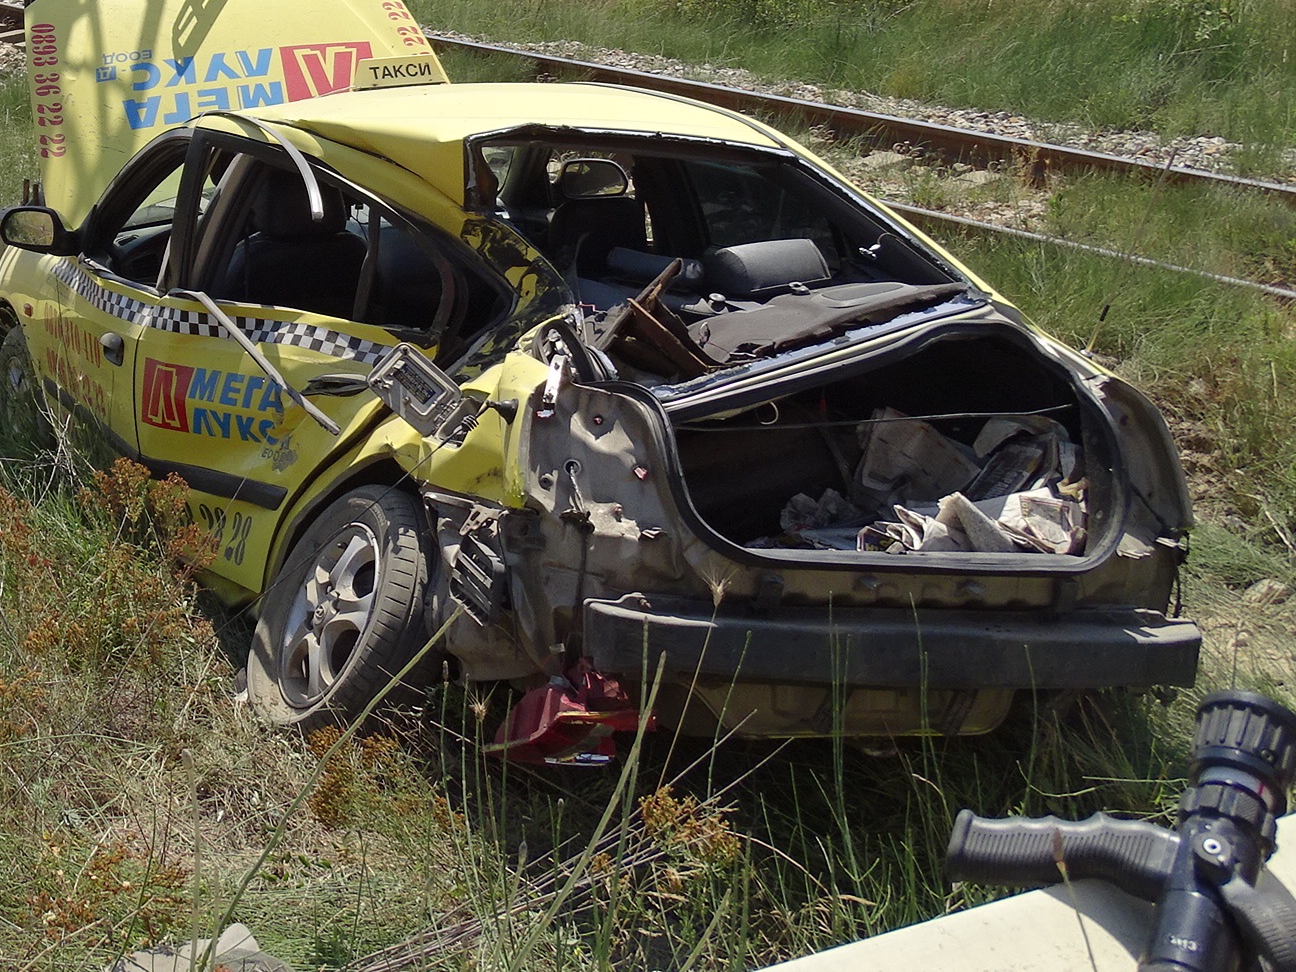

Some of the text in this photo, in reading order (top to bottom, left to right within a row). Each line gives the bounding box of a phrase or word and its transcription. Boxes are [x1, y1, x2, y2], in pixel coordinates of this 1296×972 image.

[30, 23, 66, 159] 0893 36 22 22
[368, 62, 432, 80] ТАКСИ
[188, 367, 284, 414] МЕГА
[192, 407, 280, 446] ЛУКС
[224, 511, 253, 566] 28
